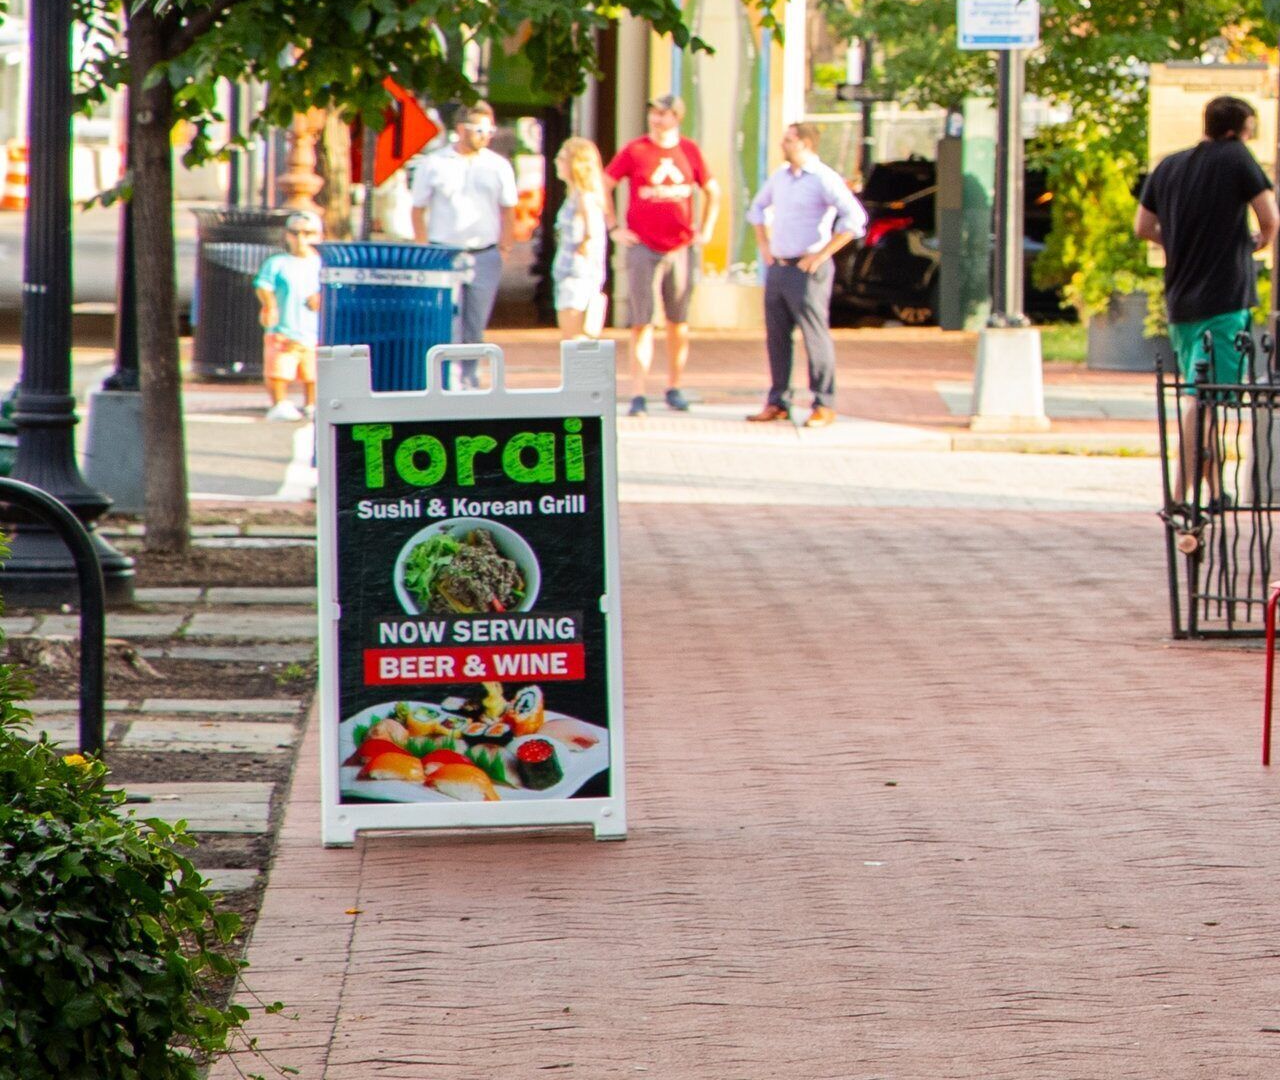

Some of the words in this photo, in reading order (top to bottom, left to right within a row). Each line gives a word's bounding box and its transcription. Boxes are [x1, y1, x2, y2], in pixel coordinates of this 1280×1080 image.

[352, 417, 585, 489] Torai
[357, 499, 420, 519] Sushi
[427, 498, 447, 517] &
[453, 497, 533, 517] Korean
[539, 495, 585, 514] Grill
[379, 621, 446, 644] NOW
[452, 617, 575, 642] SERVING
[379, 655, 455, 679] BEER
[463, 654, 486, 677] &
[492, 652, 568, 676] WINE
